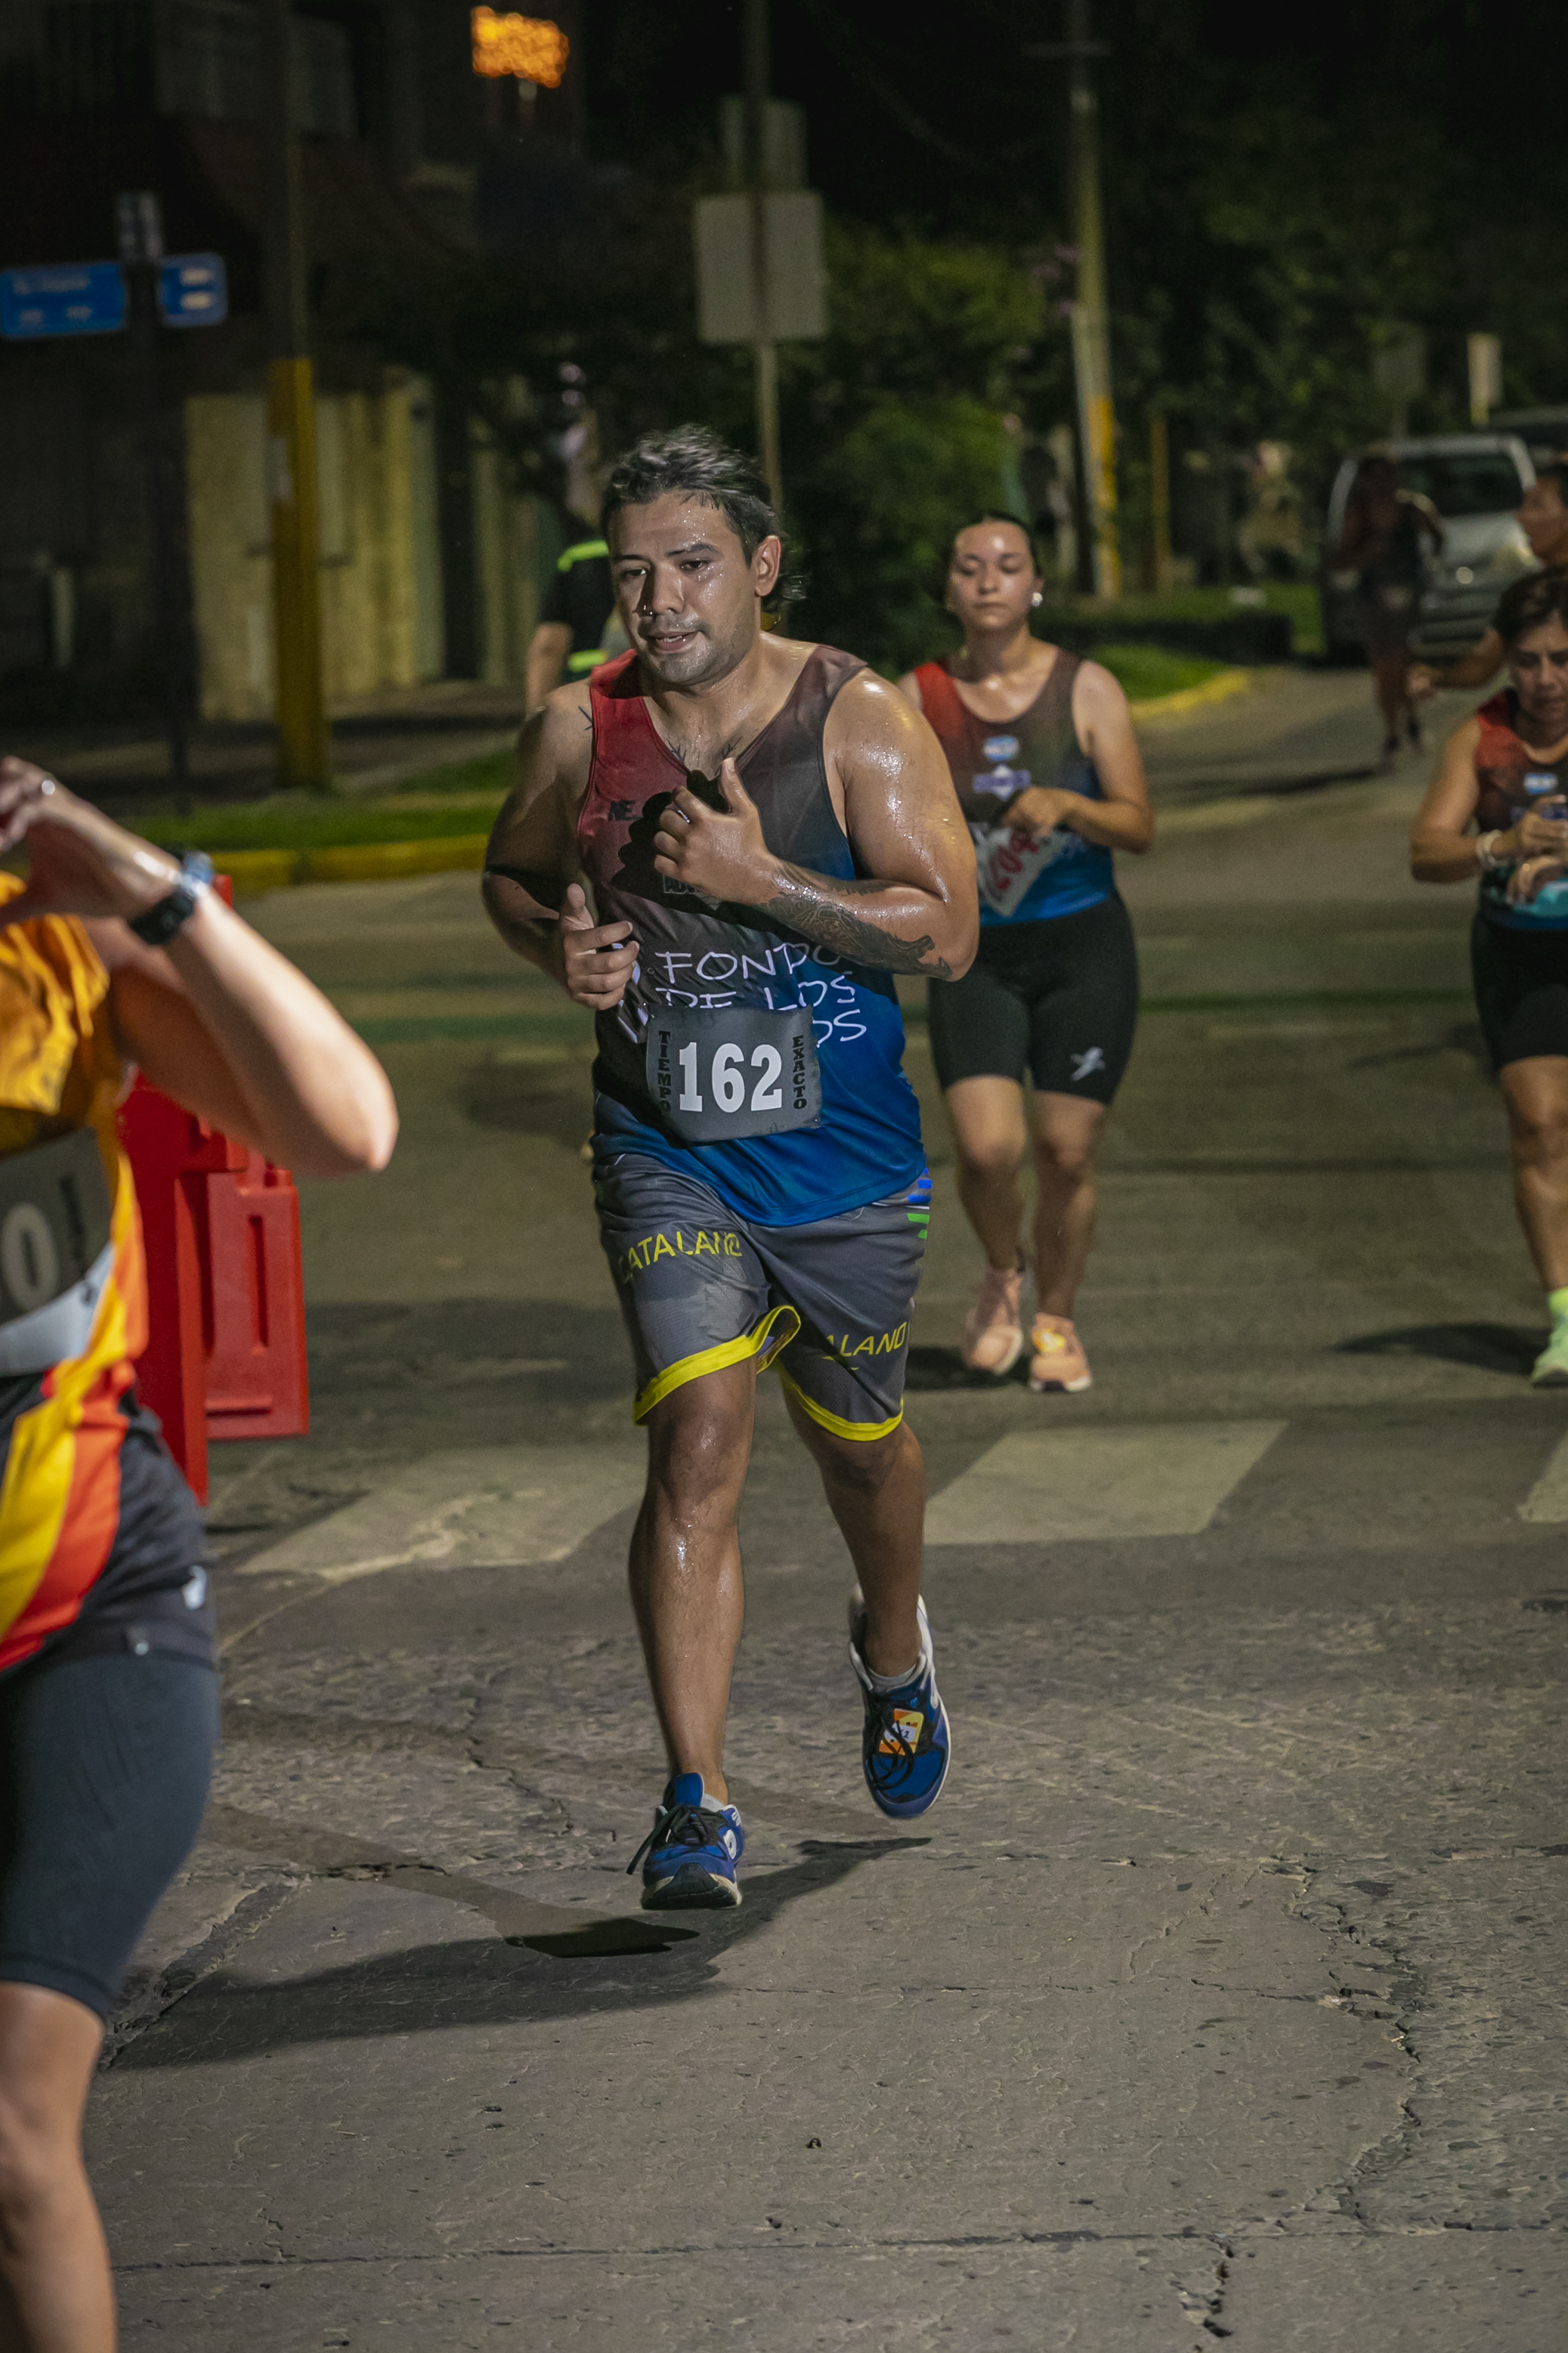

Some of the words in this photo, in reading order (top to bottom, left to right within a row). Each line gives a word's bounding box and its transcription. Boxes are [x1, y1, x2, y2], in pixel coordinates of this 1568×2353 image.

[655, 943, 841, 983] FONDO
[764, 971, 855, 1011] LOS
[657, 1030, 672, 1113] TIEMPO
[679, 1042, 782, 1113] 162
[793, 1035, 807, 1110] EXACTO
